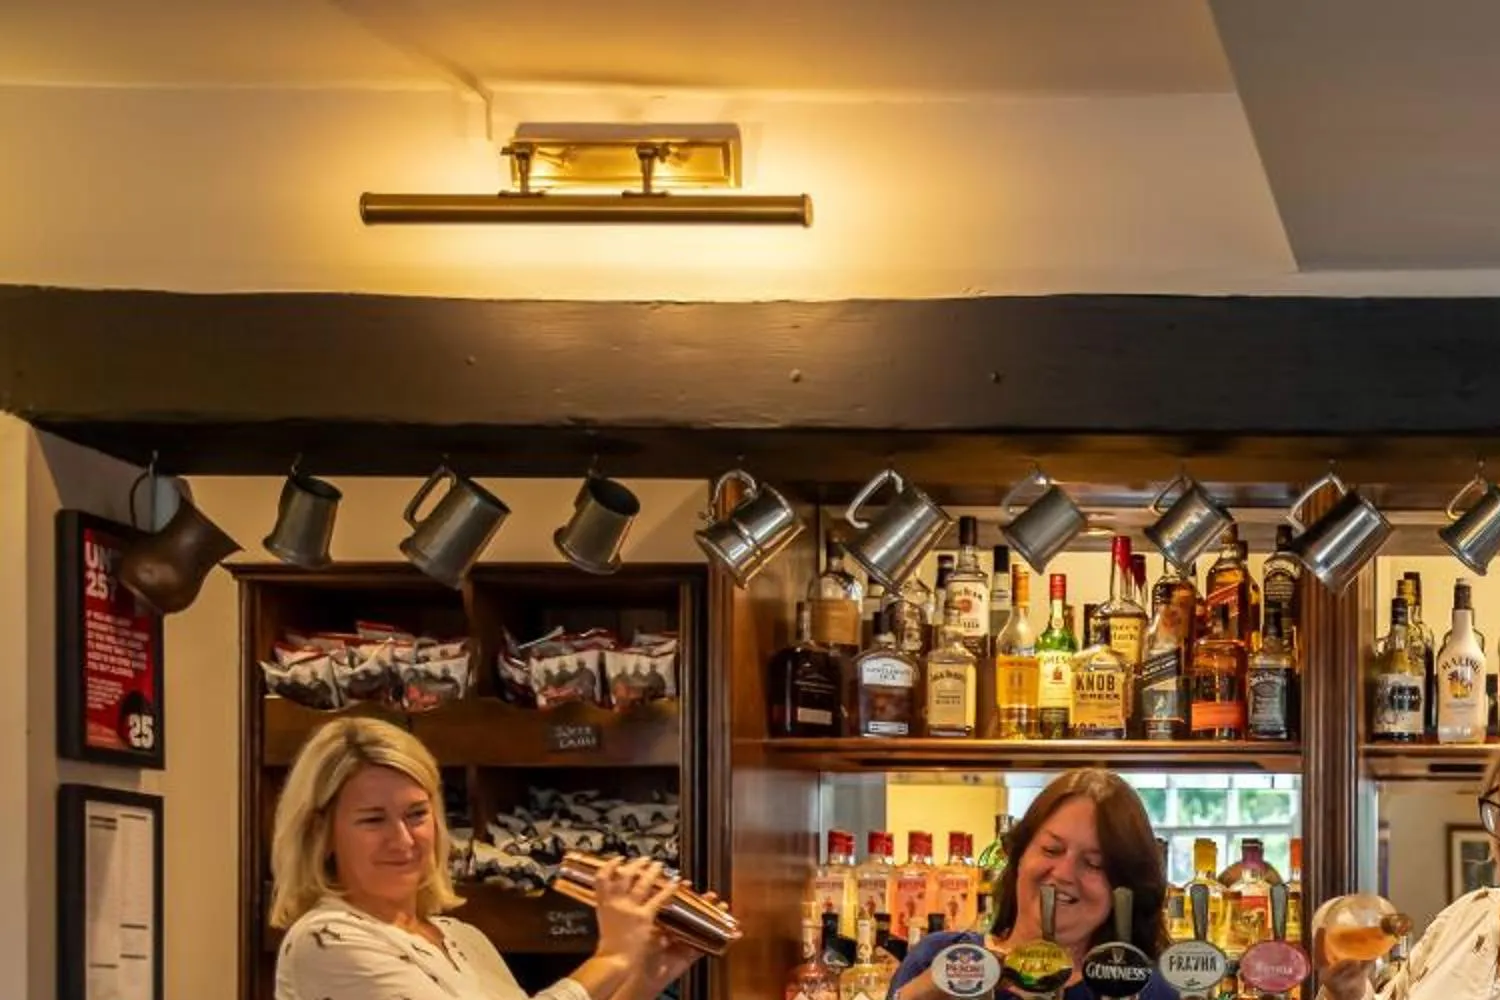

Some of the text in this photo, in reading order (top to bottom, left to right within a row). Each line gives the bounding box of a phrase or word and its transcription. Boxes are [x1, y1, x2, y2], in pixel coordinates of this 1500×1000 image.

[1075, 674, 1116, 692] KNOB
[128, 713, 154, 749] 25
[1085, 961, 1147, 981] GUINNESS
